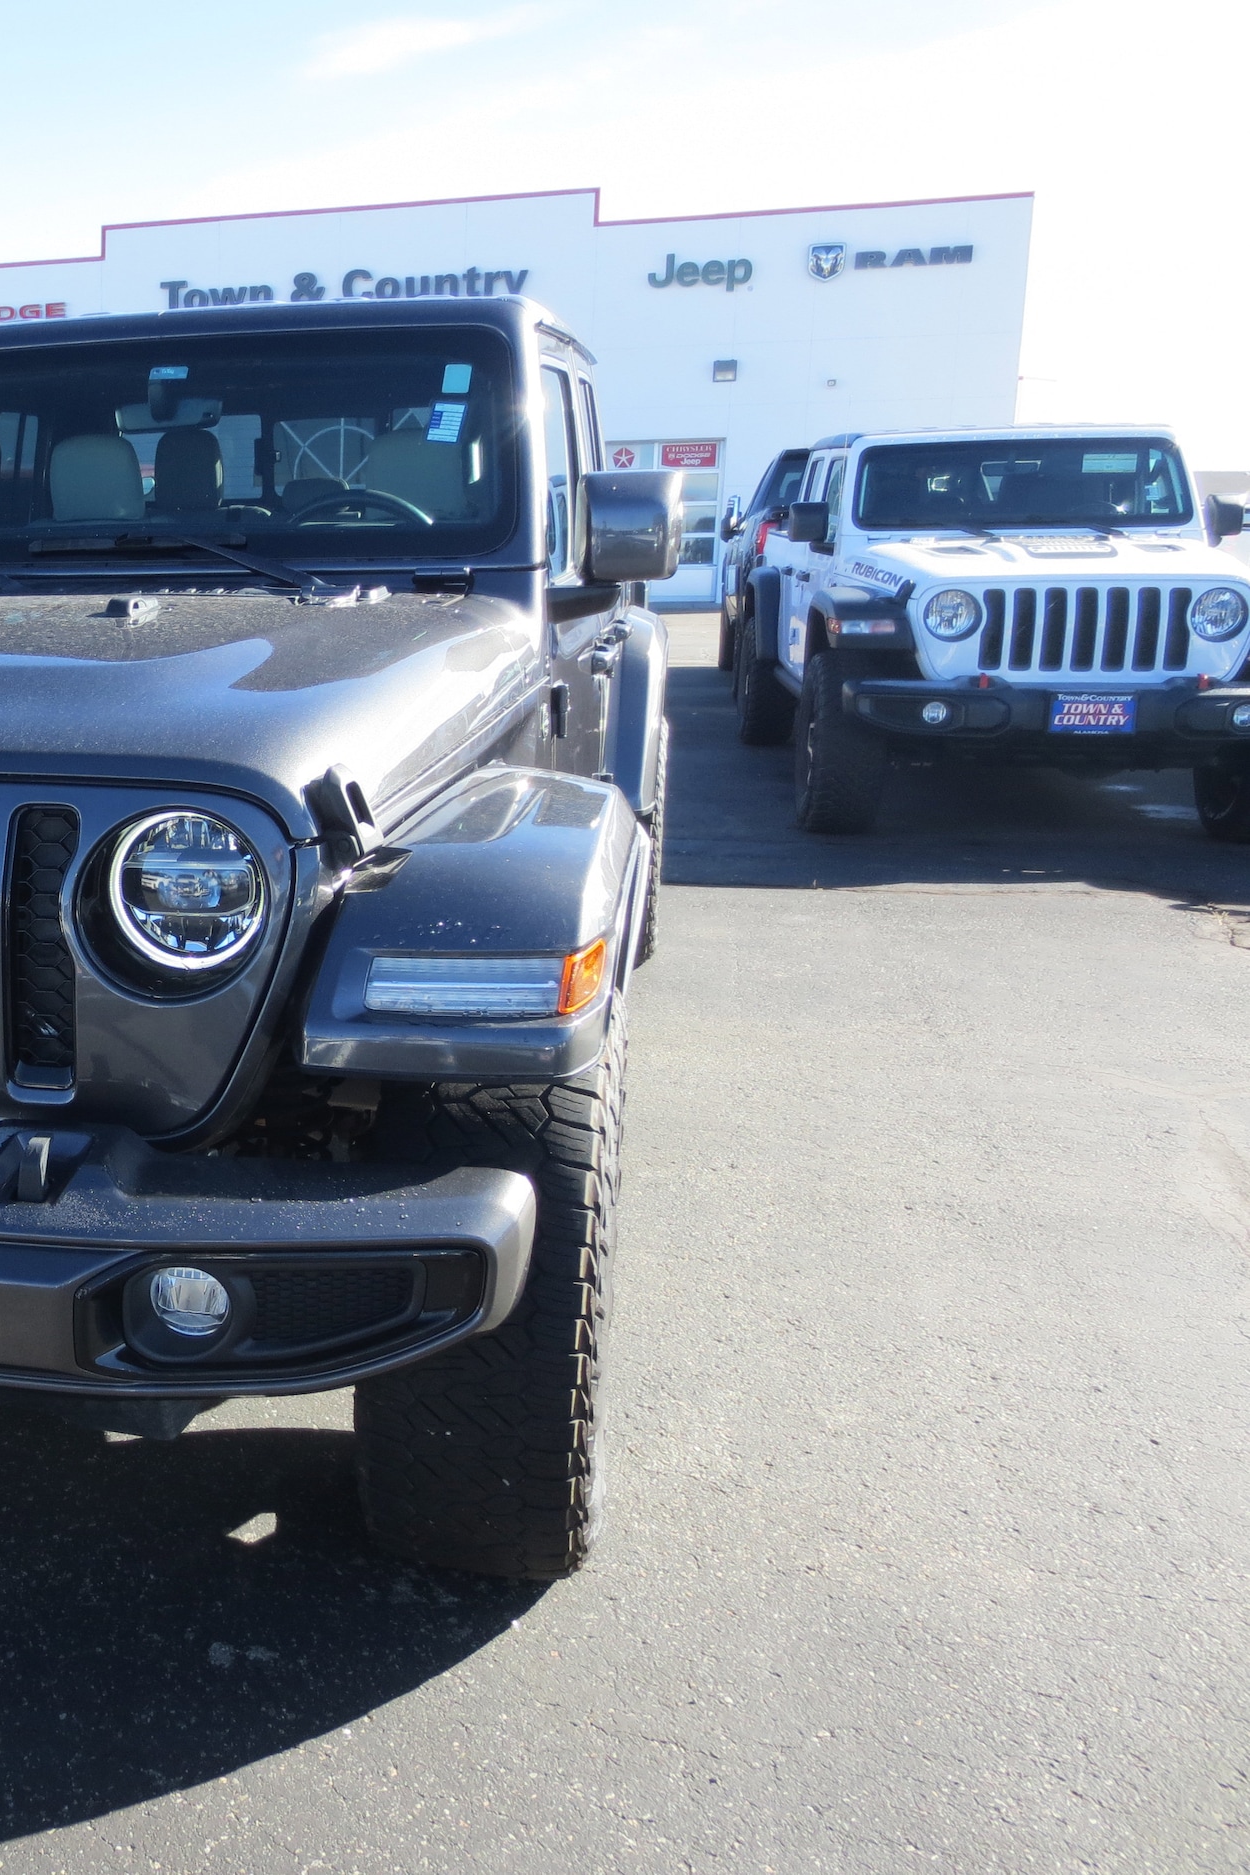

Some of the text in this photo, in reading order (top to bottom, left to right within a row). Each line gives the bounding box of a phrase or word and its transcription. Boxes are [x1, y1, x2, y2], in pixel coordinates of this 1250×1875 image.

[853, 244, 974, 271] RAM
[647, 253, 753, 292] Jeep
[160, 265, 529, 309] Town & Country
[666, 445, 712, 453] CHRYSLER
[680, 458, 702, 466] Jeep
[851, 561, 903, 588] RUBICON
[1062, 703, 1125, 714] TOWN &
[1053, 714, 1129, 726] COUNTRY
